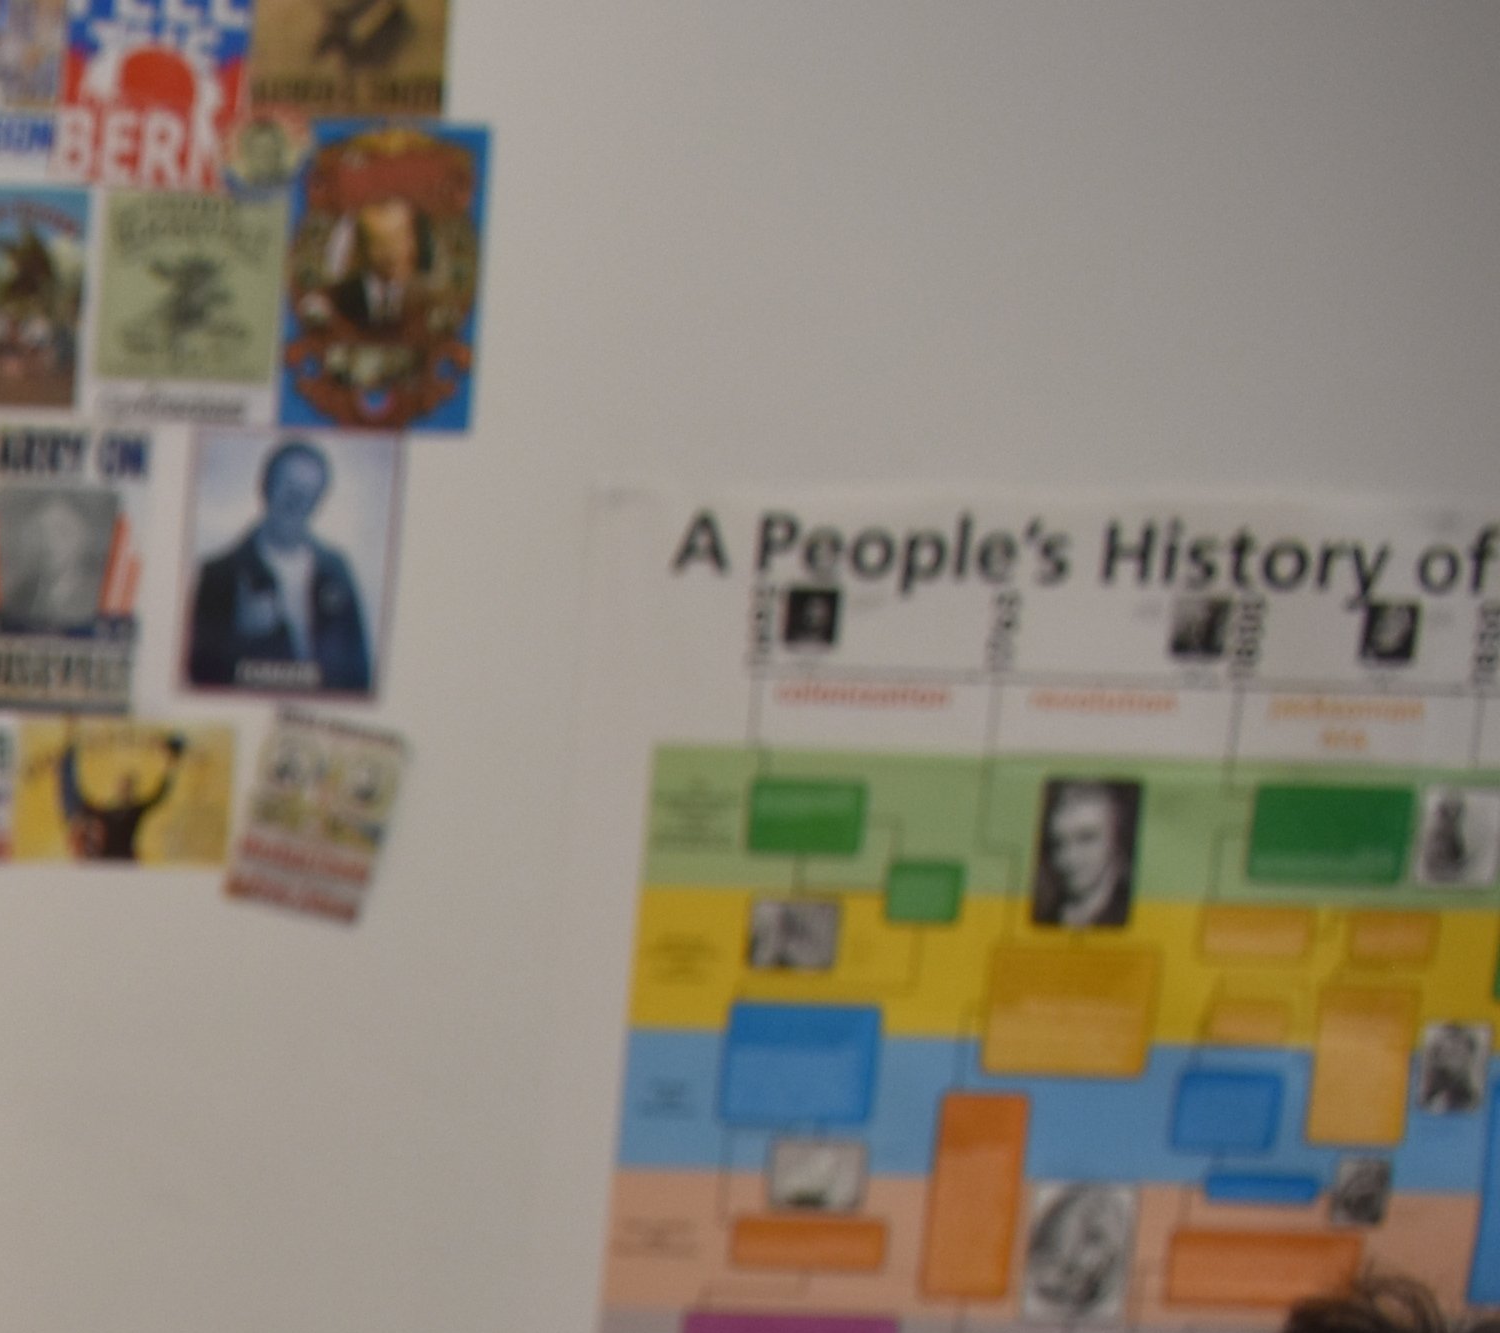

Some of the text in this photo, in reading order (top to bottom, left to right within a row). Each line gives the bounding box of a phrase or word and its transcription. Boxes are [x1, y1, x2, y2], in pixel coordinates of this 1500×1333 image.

[96, 428, 151, 476] ON
[671, 509, 1500, 612] A People's History of
